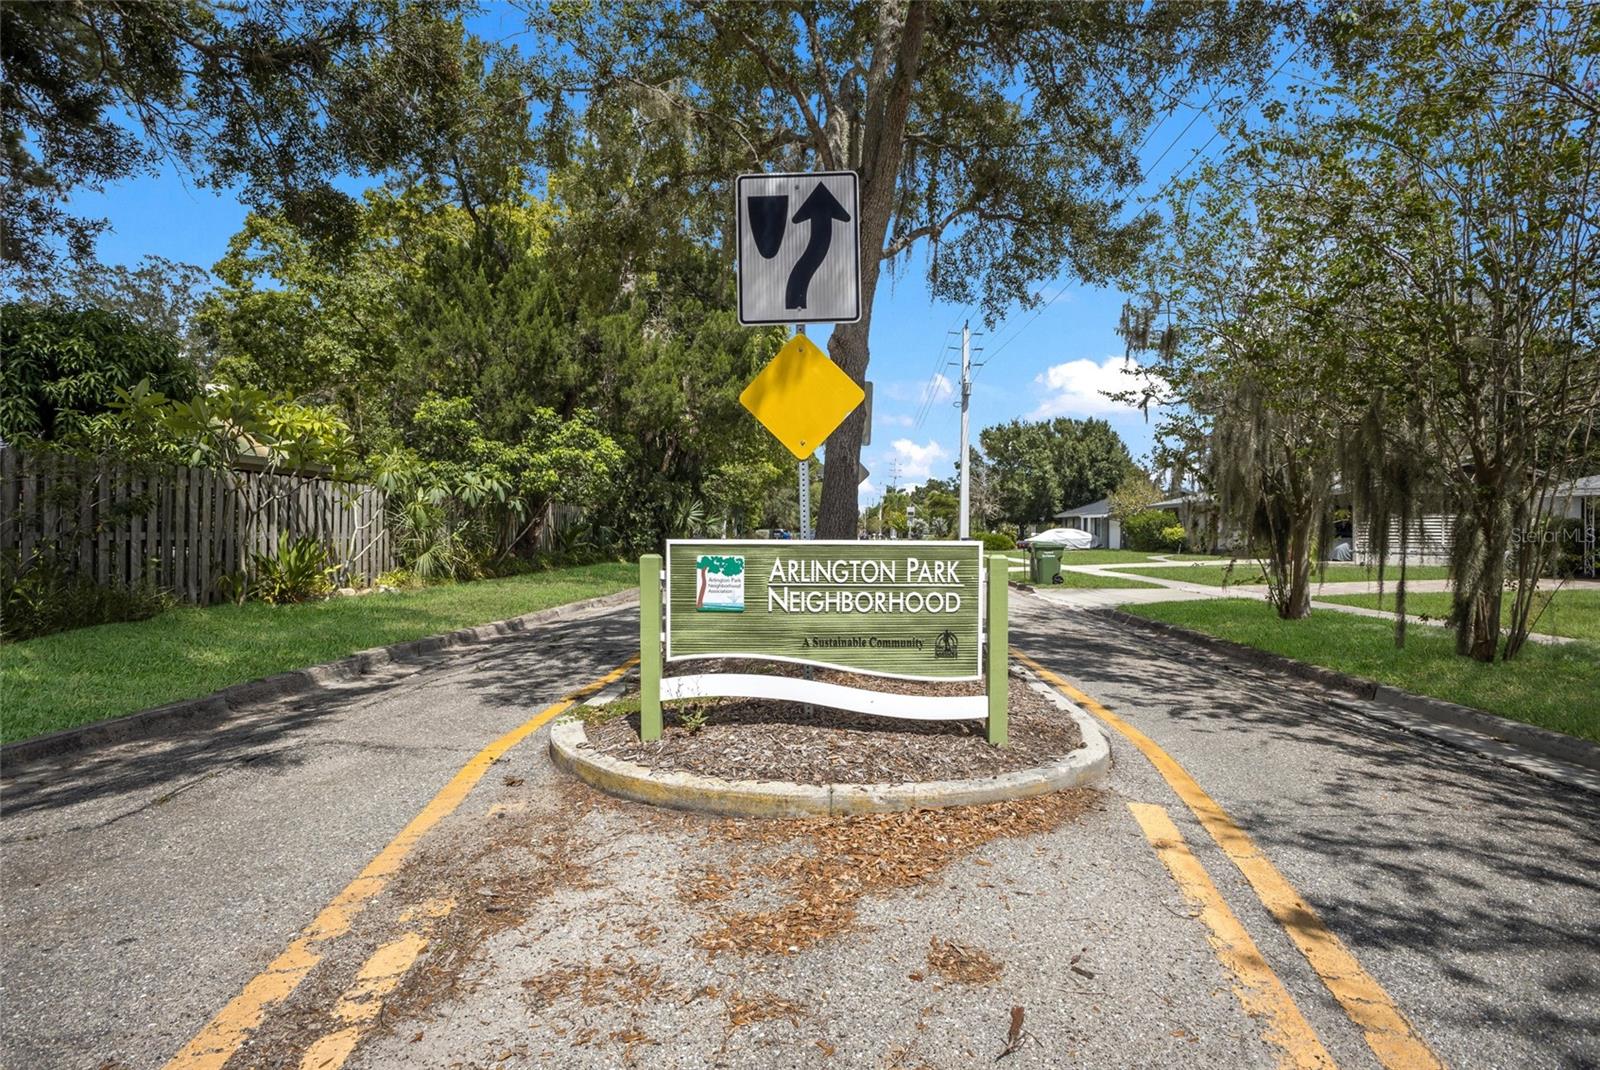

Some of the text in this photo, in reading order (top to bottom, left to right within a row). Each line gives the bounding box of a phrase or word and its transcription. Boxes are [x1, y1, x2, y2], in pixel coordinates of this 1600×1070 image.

[768, 557, 960, 583] ARLINGTON PARK
[768, 587, 961, 613] NEIGHBORHOOD
[802, 636, 924, 651] A Sustainable Community
